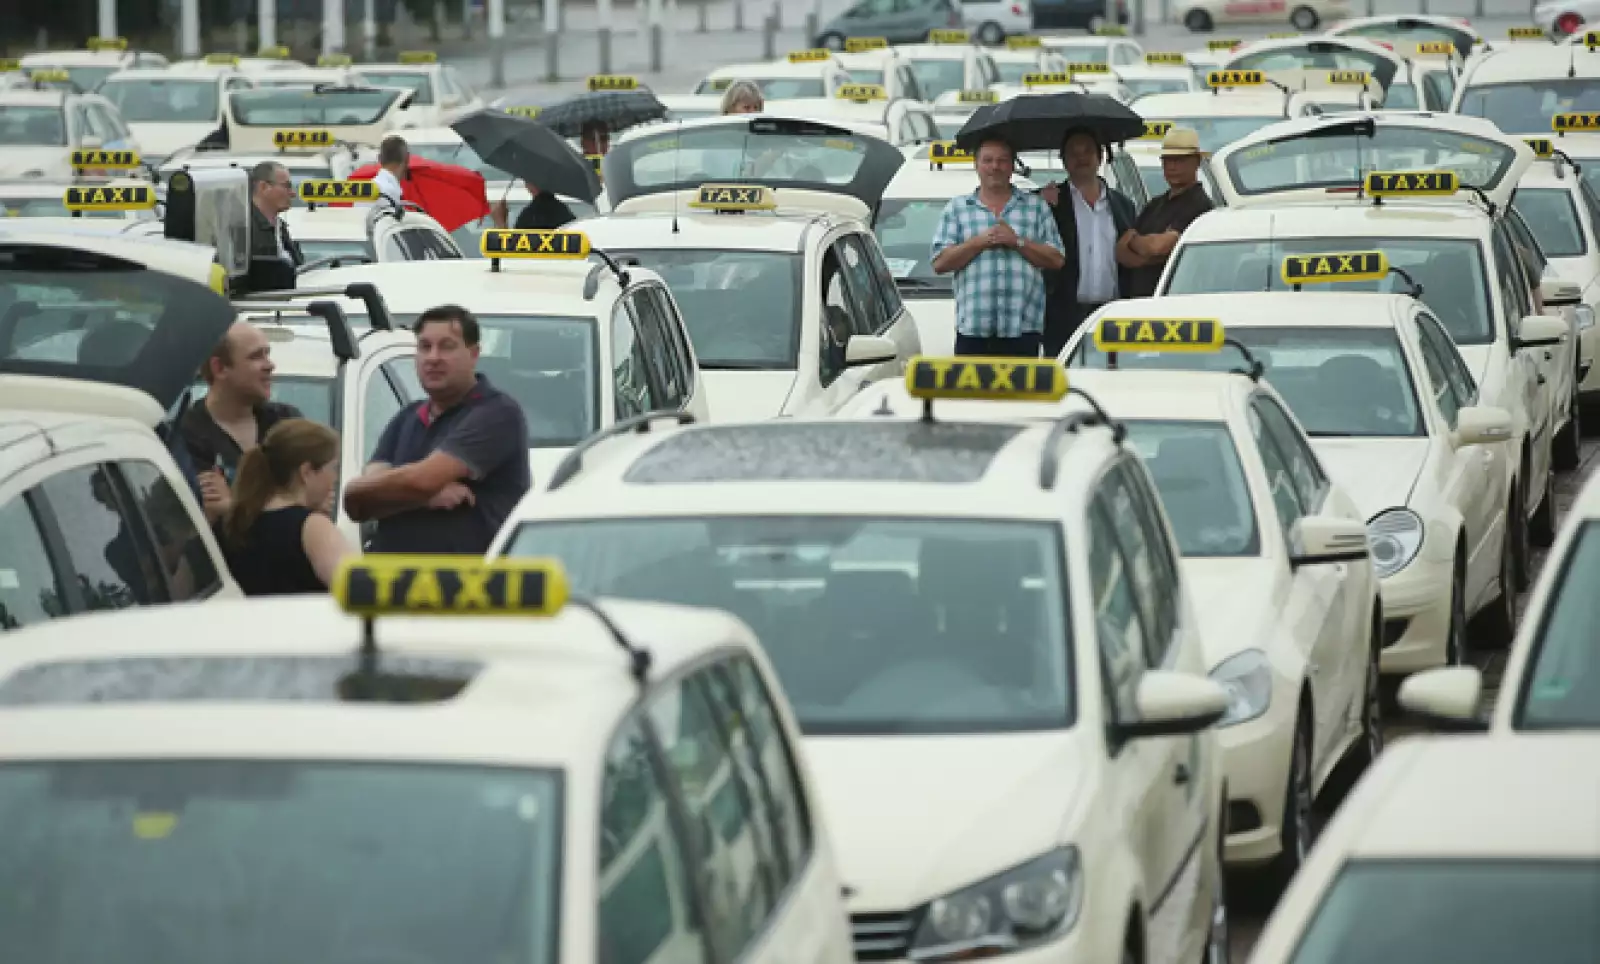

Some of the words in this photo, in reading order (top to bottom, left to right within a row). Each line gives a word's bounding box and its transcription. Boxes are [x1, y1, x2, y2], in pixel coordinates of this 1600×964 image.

[1564, 116, 1600, 127] TAX
[314, 183, 363, 196] TAXI
[1380, 175, 1442, 190] TAXI
[80, 188, 138, 203] TAXI
[706, 188, 760, 203] TAXI
[499, 233, 567, 252] TAXI
[1297, 255, 1368, 276] TAXI
[1114, 320, 1198, 341] TAXI
[930, 363, 1036, 391] TAXI
[368, 568, 524, 609] TAXI
